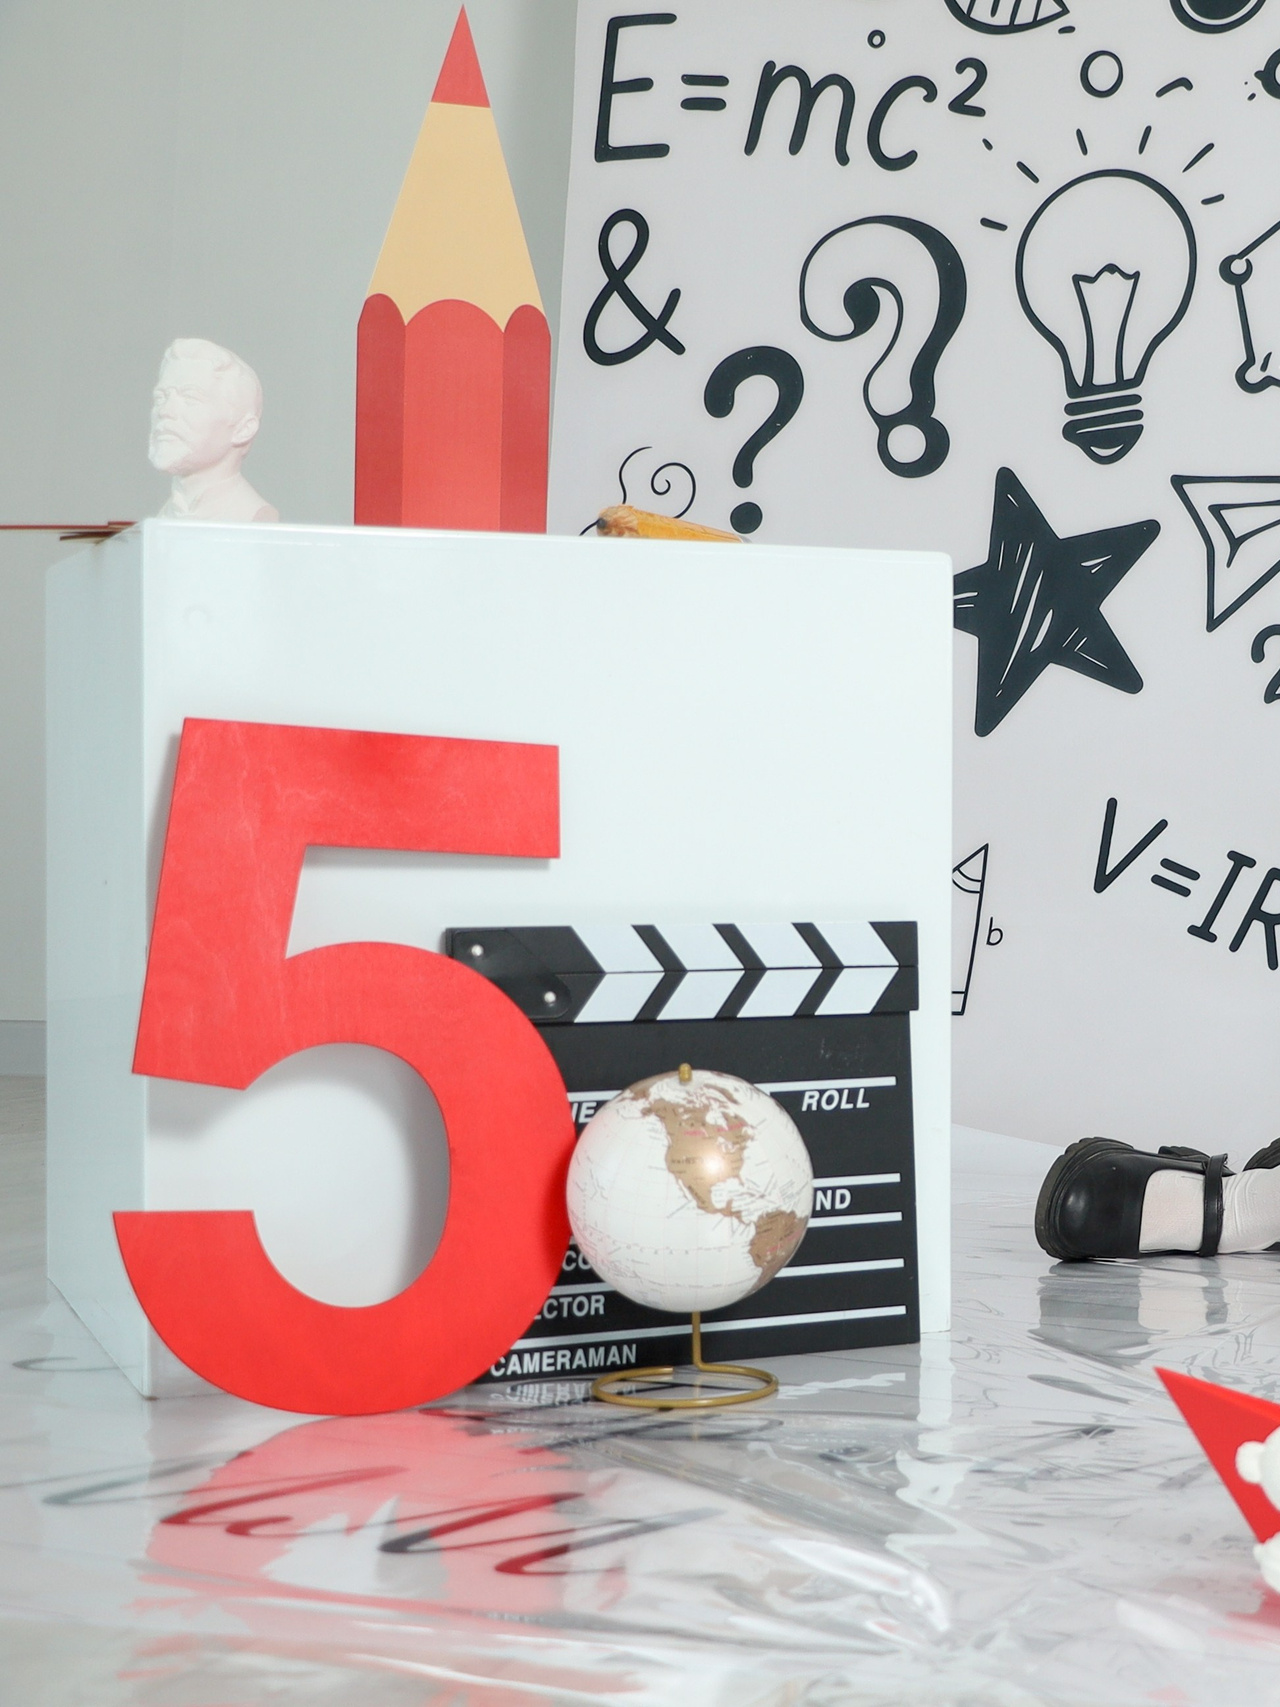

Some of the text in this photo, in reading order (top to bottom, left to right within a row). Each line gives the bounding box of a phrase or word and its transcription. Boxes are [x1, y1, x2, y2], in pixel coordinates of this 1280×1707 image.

[986, 916, 1004, 946] b
[112, 717, 577, 1416] 5
[801, 1088, 870, 1111] ROLL
[490, 1344, 637, 1377] CAMERAMAN
